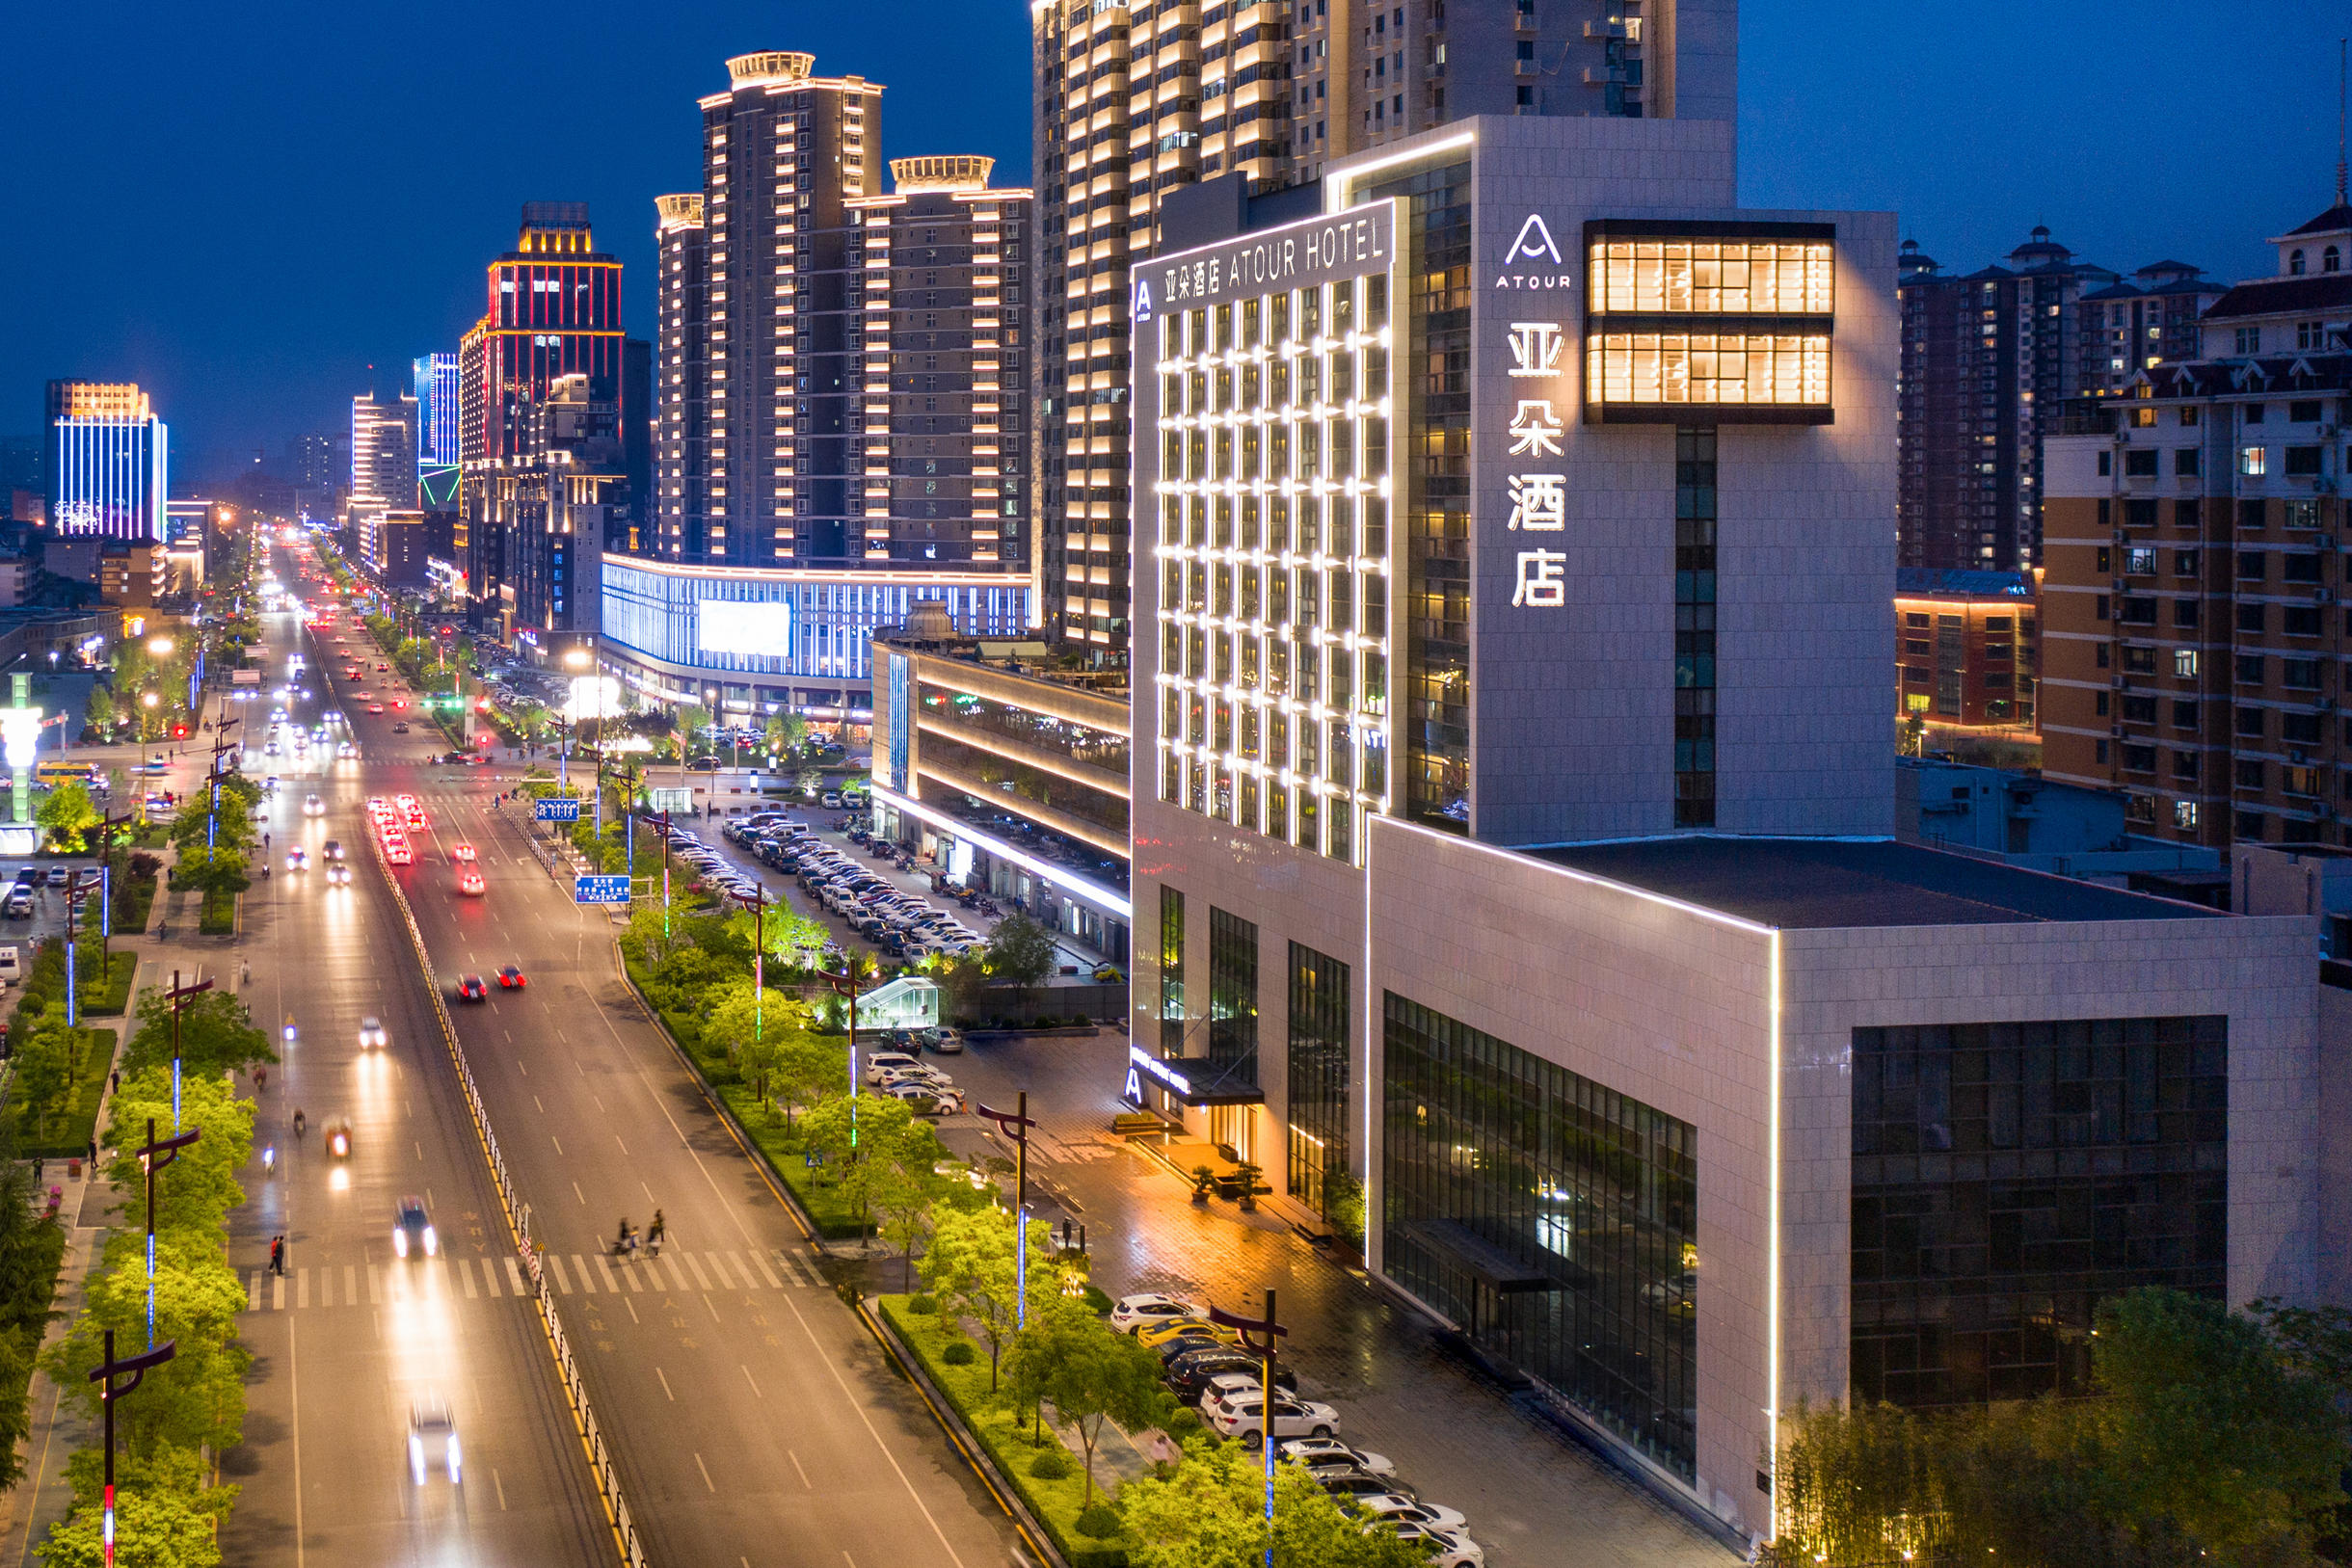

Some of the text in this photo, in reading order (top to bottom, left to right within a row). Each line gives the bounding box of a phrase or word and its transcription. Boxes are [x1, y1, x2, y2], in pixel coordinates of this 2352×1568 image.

[1164, 219, 1383, 303] 亚朵酒店 ATOUR HOTEL
[1496, 276, 1571, 289] ATOUR
[1507, 322, 1567, 609] 亚朵酒店
